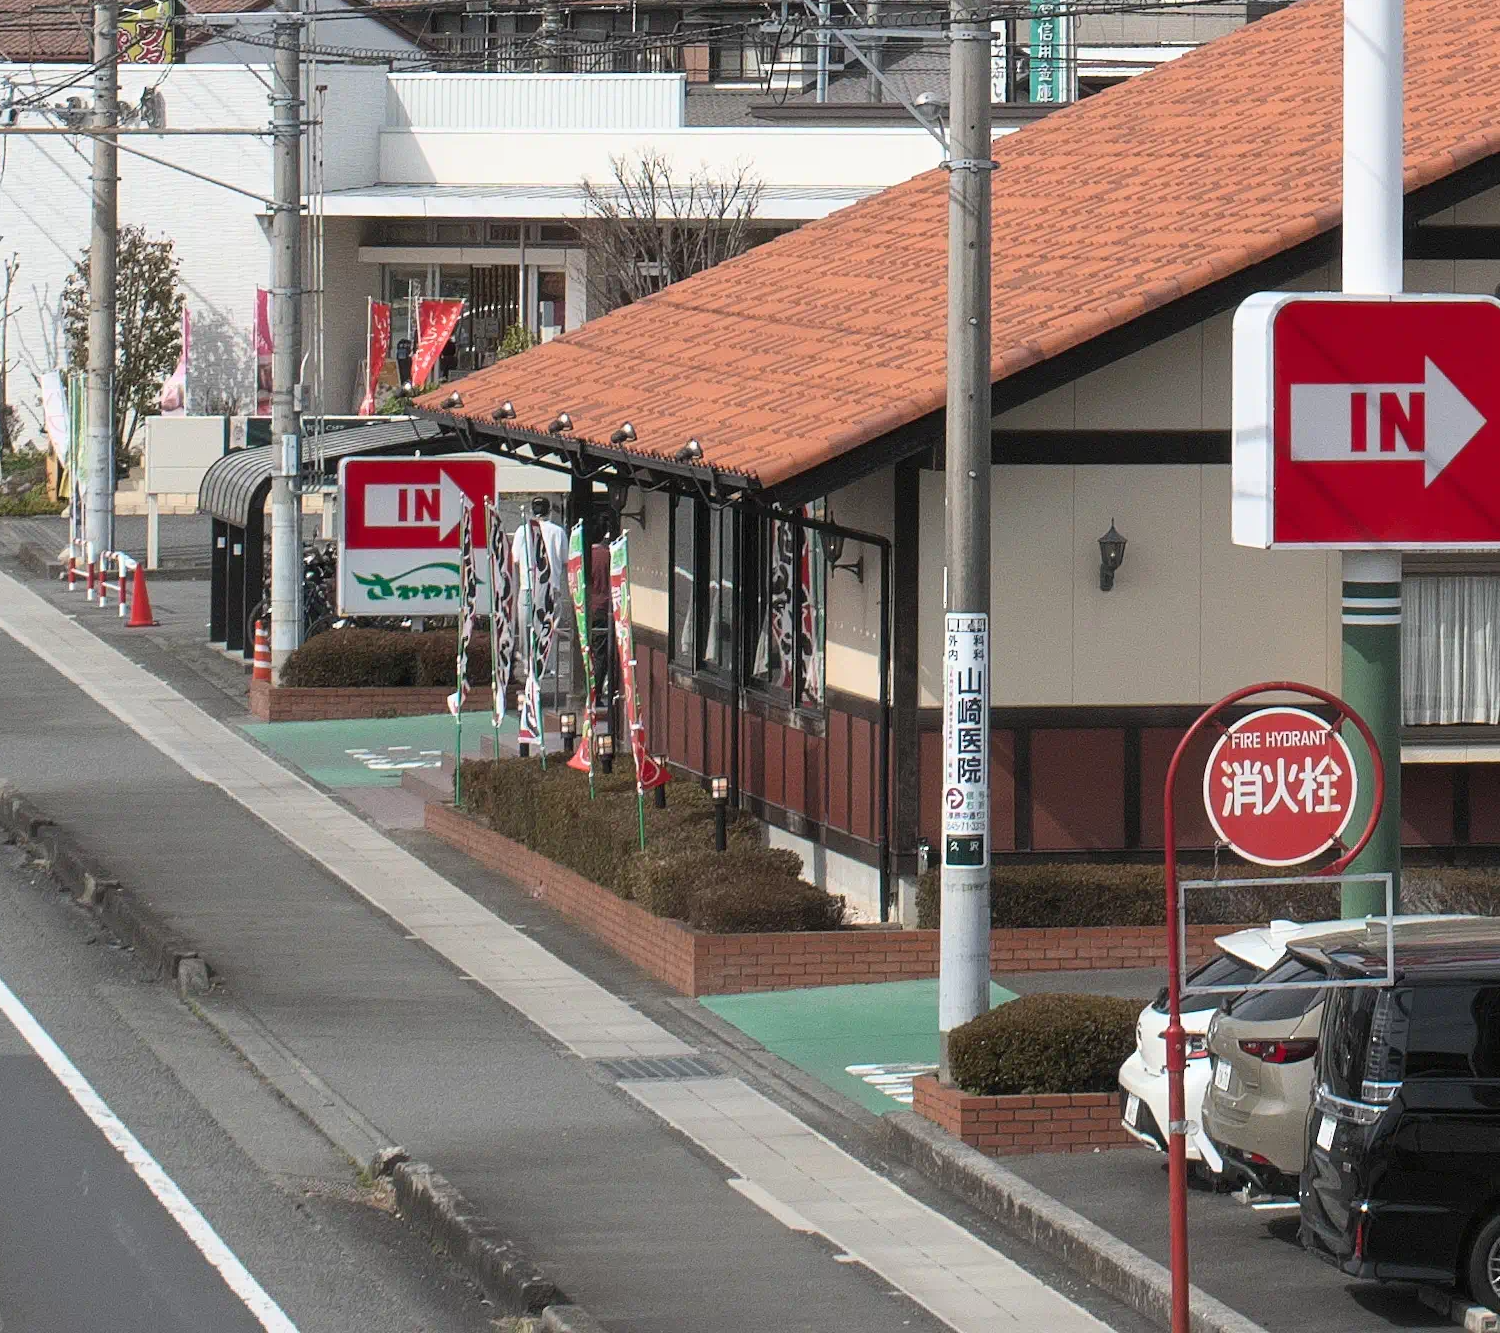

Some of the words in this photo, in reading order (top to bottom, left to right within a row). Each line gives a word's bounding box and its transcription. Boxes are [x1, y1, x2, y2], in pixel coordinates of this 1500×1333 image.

[1350, 392, 1424, 451] IN
[398, 489, 440, 521] IN
[957, 666, 982, 784] 山崎医院
[1231, 733, 1261, 749] FIRE
[1266, 730, 1328, 747] HYDRANT
[1221, 755, 1343, 817] 消火栓
[950, 841, 980, 852] 久沢
